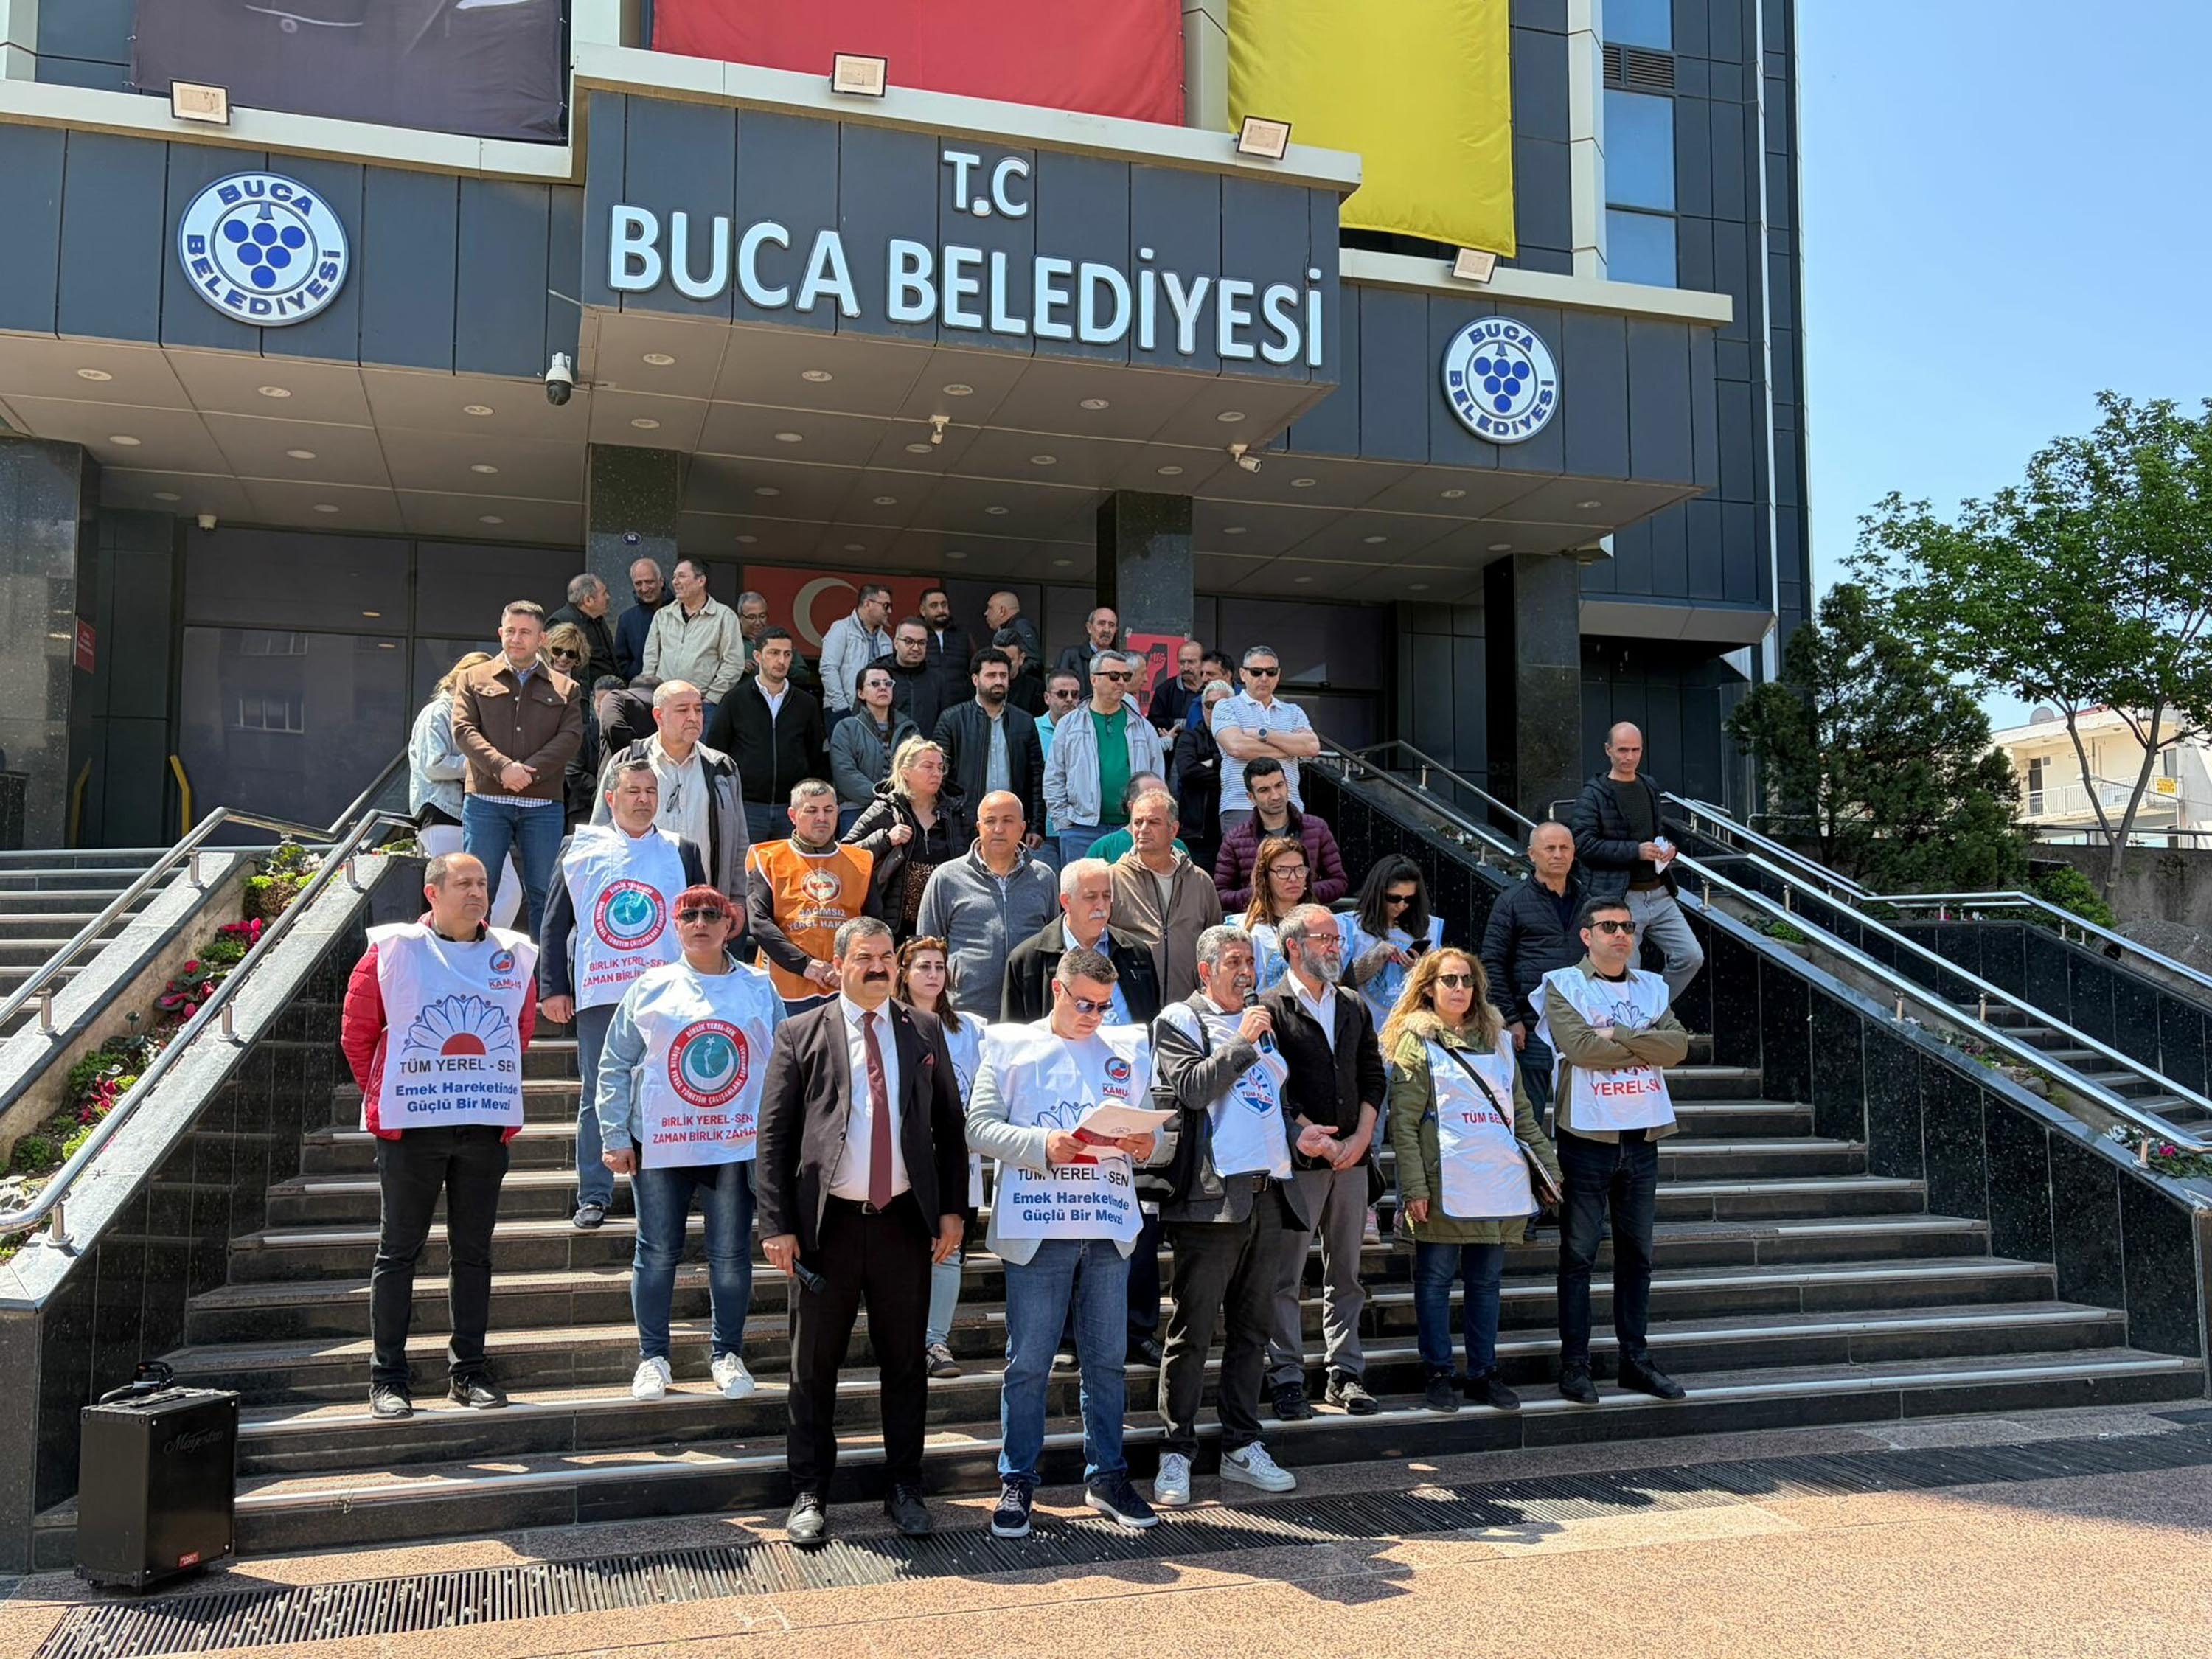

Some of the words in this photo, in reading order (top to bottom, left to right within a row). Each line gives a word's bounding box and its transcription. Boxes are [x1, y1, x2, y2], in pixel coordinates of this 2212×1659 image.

[943, 150, 1029, 218] T.C
[217, 180, 313, 216] BUCA
[187, 234, 341, 315] BELEDİYESİ
[609, 203, 860, 317] BUCA
[887, 237, 1323, 367] BELEDİYESİ
[1468, 323, 1533, 352] BUCA
[589, 957, 619, 972] BİRLİK
[583, 973, 613, 987] ZAMAN
[400, 1058, 431, 1074] TÜM
[436, 1058, 486, 1071] YEREL
[396, 1083, 437, 1096] Emek
[442, 1082, 518, 1095] Hareketinde
[407, 1099, 451, 1114] Güçlü
[456, 1098, 478, 1109] Bir
[481, 1099, 510, 1110] Mevzi
[662, 1113, 693, 1127] BİRLİK
[696, 1113, 754, 1126] YEREL-SEN
[653, 1132, 686, 1144] ZAMAN
[689, 1129, 723, 1142] BİRLİK
[726, 1127, 757, 1140] ZAMA
[1051, 1168, 1099, 1180] YEREL
[1108, 1171, 1130, 1187] SEN
[1013, 1192, 1051, 1204] Emek
[1057, 1192, 1130, 1210] Hareketinde
[1023, 1209, 1064, 1224] Güçlü
[1071, 1210, 1091, 1221] Bir
[1096, 1210, 1123, 1225] Mevzi
